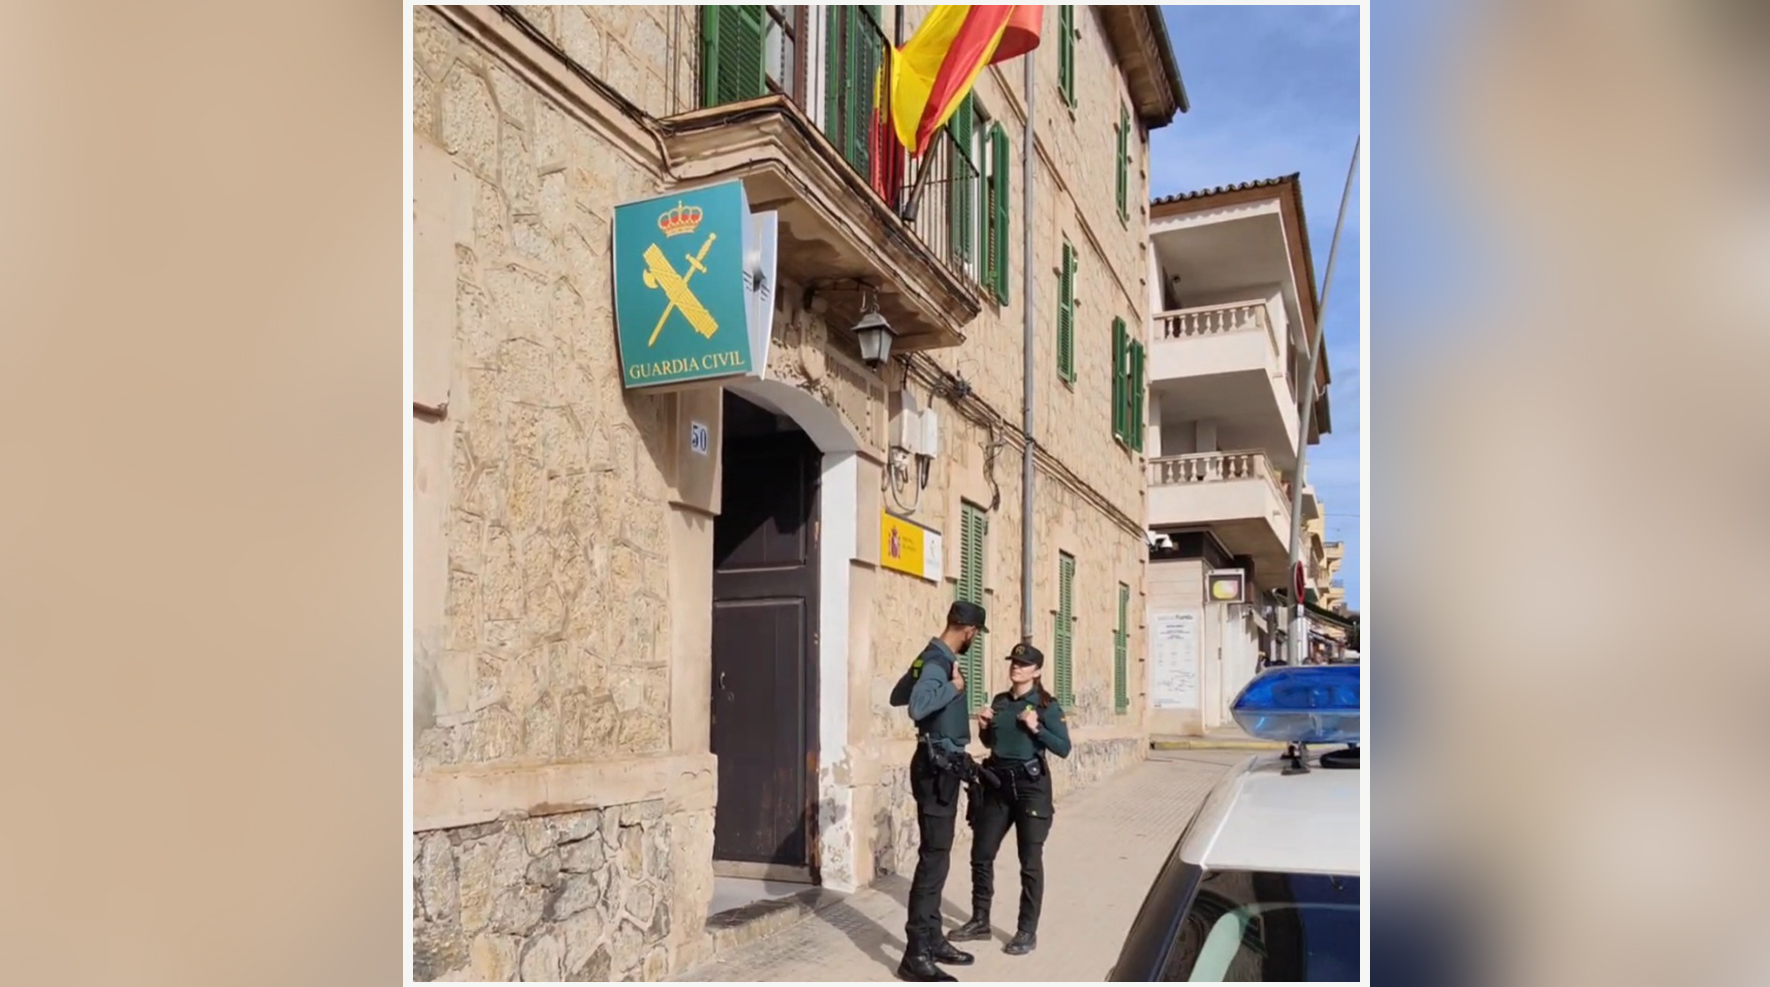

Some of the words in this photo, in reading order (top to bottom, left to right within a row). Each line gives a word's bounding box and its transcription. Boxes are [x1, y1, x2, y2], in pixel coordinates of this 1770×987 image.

[629, 357, 700, 379] GUARDIA
[702, 351, 745, 370] CIVIL
[692, 424, 707, 452] 50
